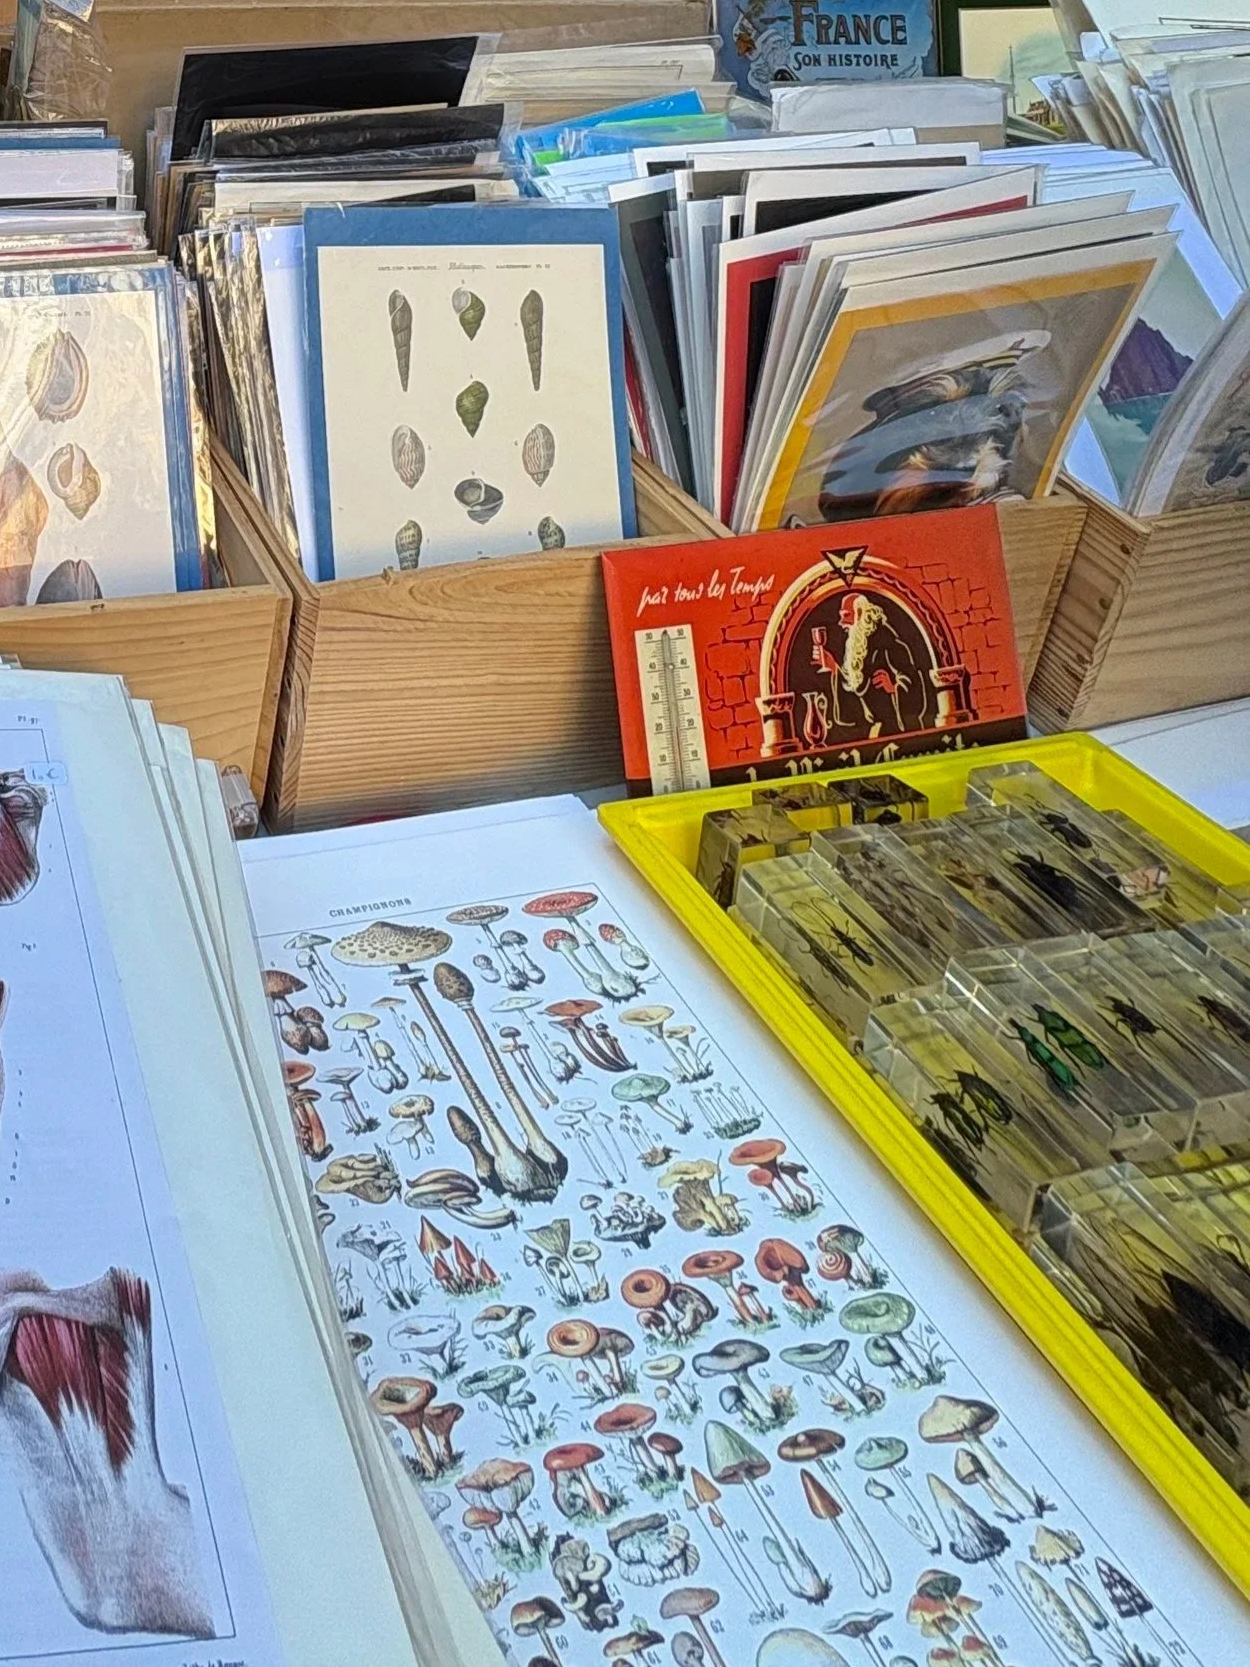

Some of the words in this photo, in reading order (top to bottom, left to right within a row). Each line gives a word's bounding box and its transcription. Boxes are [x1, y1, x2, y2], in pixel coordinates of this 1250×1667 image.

[789, 0, 908, 47] FRANCE
[793, 50, 824, 70] SON
[828, 52, 900, 69] HISTOIRE
[636, 586, 669, 618] par
[674, 582, 704, 603] tous
[707, 569, 727, 600] les
[730, 566, 776, 602] Temps
[649, 662, 656, 670] 40
[652, 692, 660, 700] 30
[683, 688, 690, 696] 30
[655, 723, 663, 731] 20
[687, 718, 694, 726] 20
[660, 754, 667, 762] 10
[329, 897, 412, 919] CHAMPIGNONS
